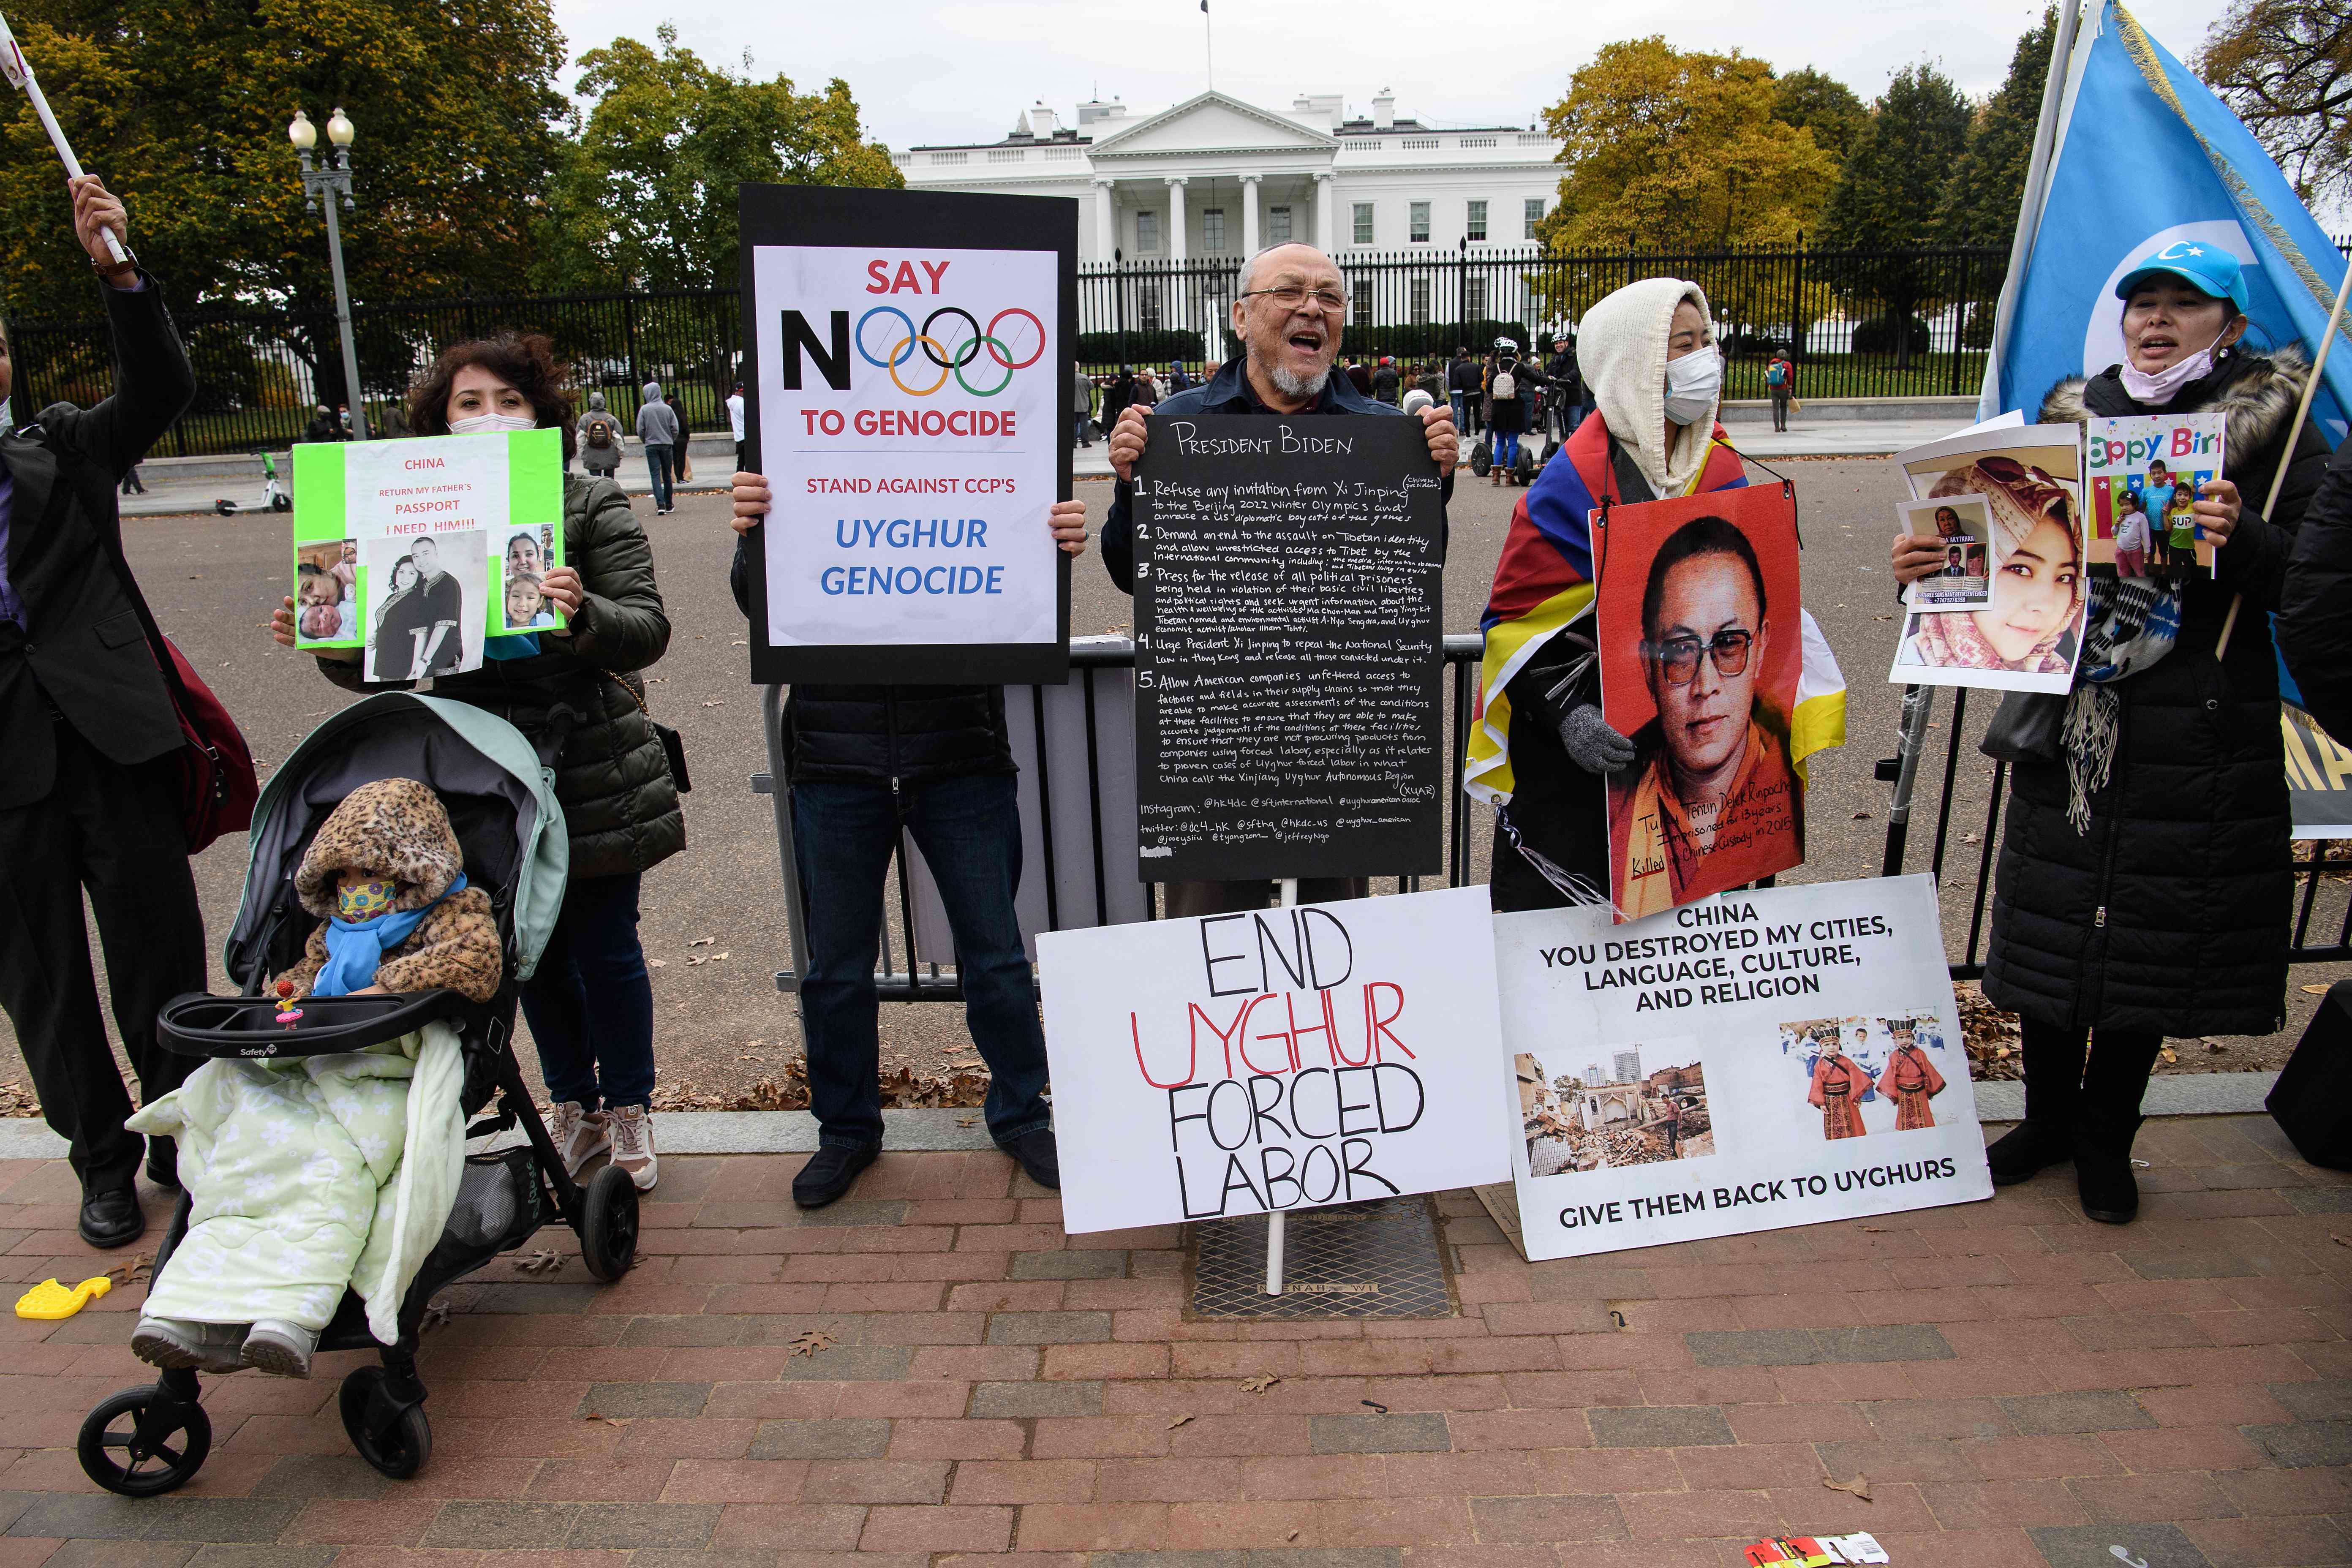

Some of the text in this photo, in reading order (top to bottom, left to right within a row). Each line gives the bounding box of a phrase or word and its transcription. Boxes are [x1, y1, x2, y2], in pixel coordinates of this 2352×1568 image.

[867, 260, 950, 294] SAY
[801, 410, 1015, 436] TO GENOCIDE
[1170, 422, 1352, 455] PRESIDENT BIDEN
[406, 459, 444, 469] CHINA
[379, 487, 414, 497] RETURN
[415, 487, 430, 495] MY
[808, 479, 1015, 493] STAND AGAINST CCP'S
[1134, 476, 1408, 510] 1. Refuse any invitation from Xi Jinping
[395, 500, 460, 514] PASSPORT
[1152, 499, 1402, 516] to the Beijing 2022 Winter Olympics and
[386, 519, 475, 535] I NEED HIM!!!
[836, 519, 987, 547] UYGHUR
[1137, 524, 1152, 539] 2.
[1155, 527, 1197, 540] Demand
[1241, 531, 1252, 539] to
[1254, 531, 1271, 539] the
[1276, 531, 1317, 541] assault
[1336, 532, 1380, 542] Tibetan
[1384, 535, 1429, 553] identity
[821, 565, 1005, 595] GENOCIDE
[1138, 563, 1413, 587] 3. Press for the release of all political prisoners
[1138, 633, 1432, 653] 4. Urge President Xi Jinping to repeal the National Security
[1192, 653, 1216, 665] Hong
[1218, 654, 1239, 663] Kong
[1245, 653, 1262, 661] and
[1341, 653, 1378, 662] convicted
[1139, 670, 1156, 688] 5.
[1159, 675, 1188, 691] Allow
[1194, 675, 1244, 686] American
[1250, 672, 1300, 684] companies
[1309, 670, 1360, 680] unfettered
[1633, 855, 1665, 877] Killed
[1683, 841, 1718, 861] Chinese
[1718, 831, 1752, 850] Custody
[1756, 828, 1764, 836] in
[1766, 816, 1791, 835] 2015
[1677, 903, 1759, 928] CHINA
[1200, 908, 1352, 997] END
[1539, 916, 1892, 967] YOU DESTROYED MY CITIES,
[1585, 945, 1860, 990] LANGUAGE, CULTURE,
[1636, 970, 1819, 1012] AND RELIGION
[1131, 982, 1416, 1089] UYGHUR
[240, 1048, 267, 1056] Safety
[1168, 1062, 1424, 1152] FORCED
[1176, 1138, 1400, 1219] LABOR
[1560, 1158, 1955, 1228] GIVE THEM BACK TO UYGHURS
[1779, 1541, 1796, 1559] Scotch
